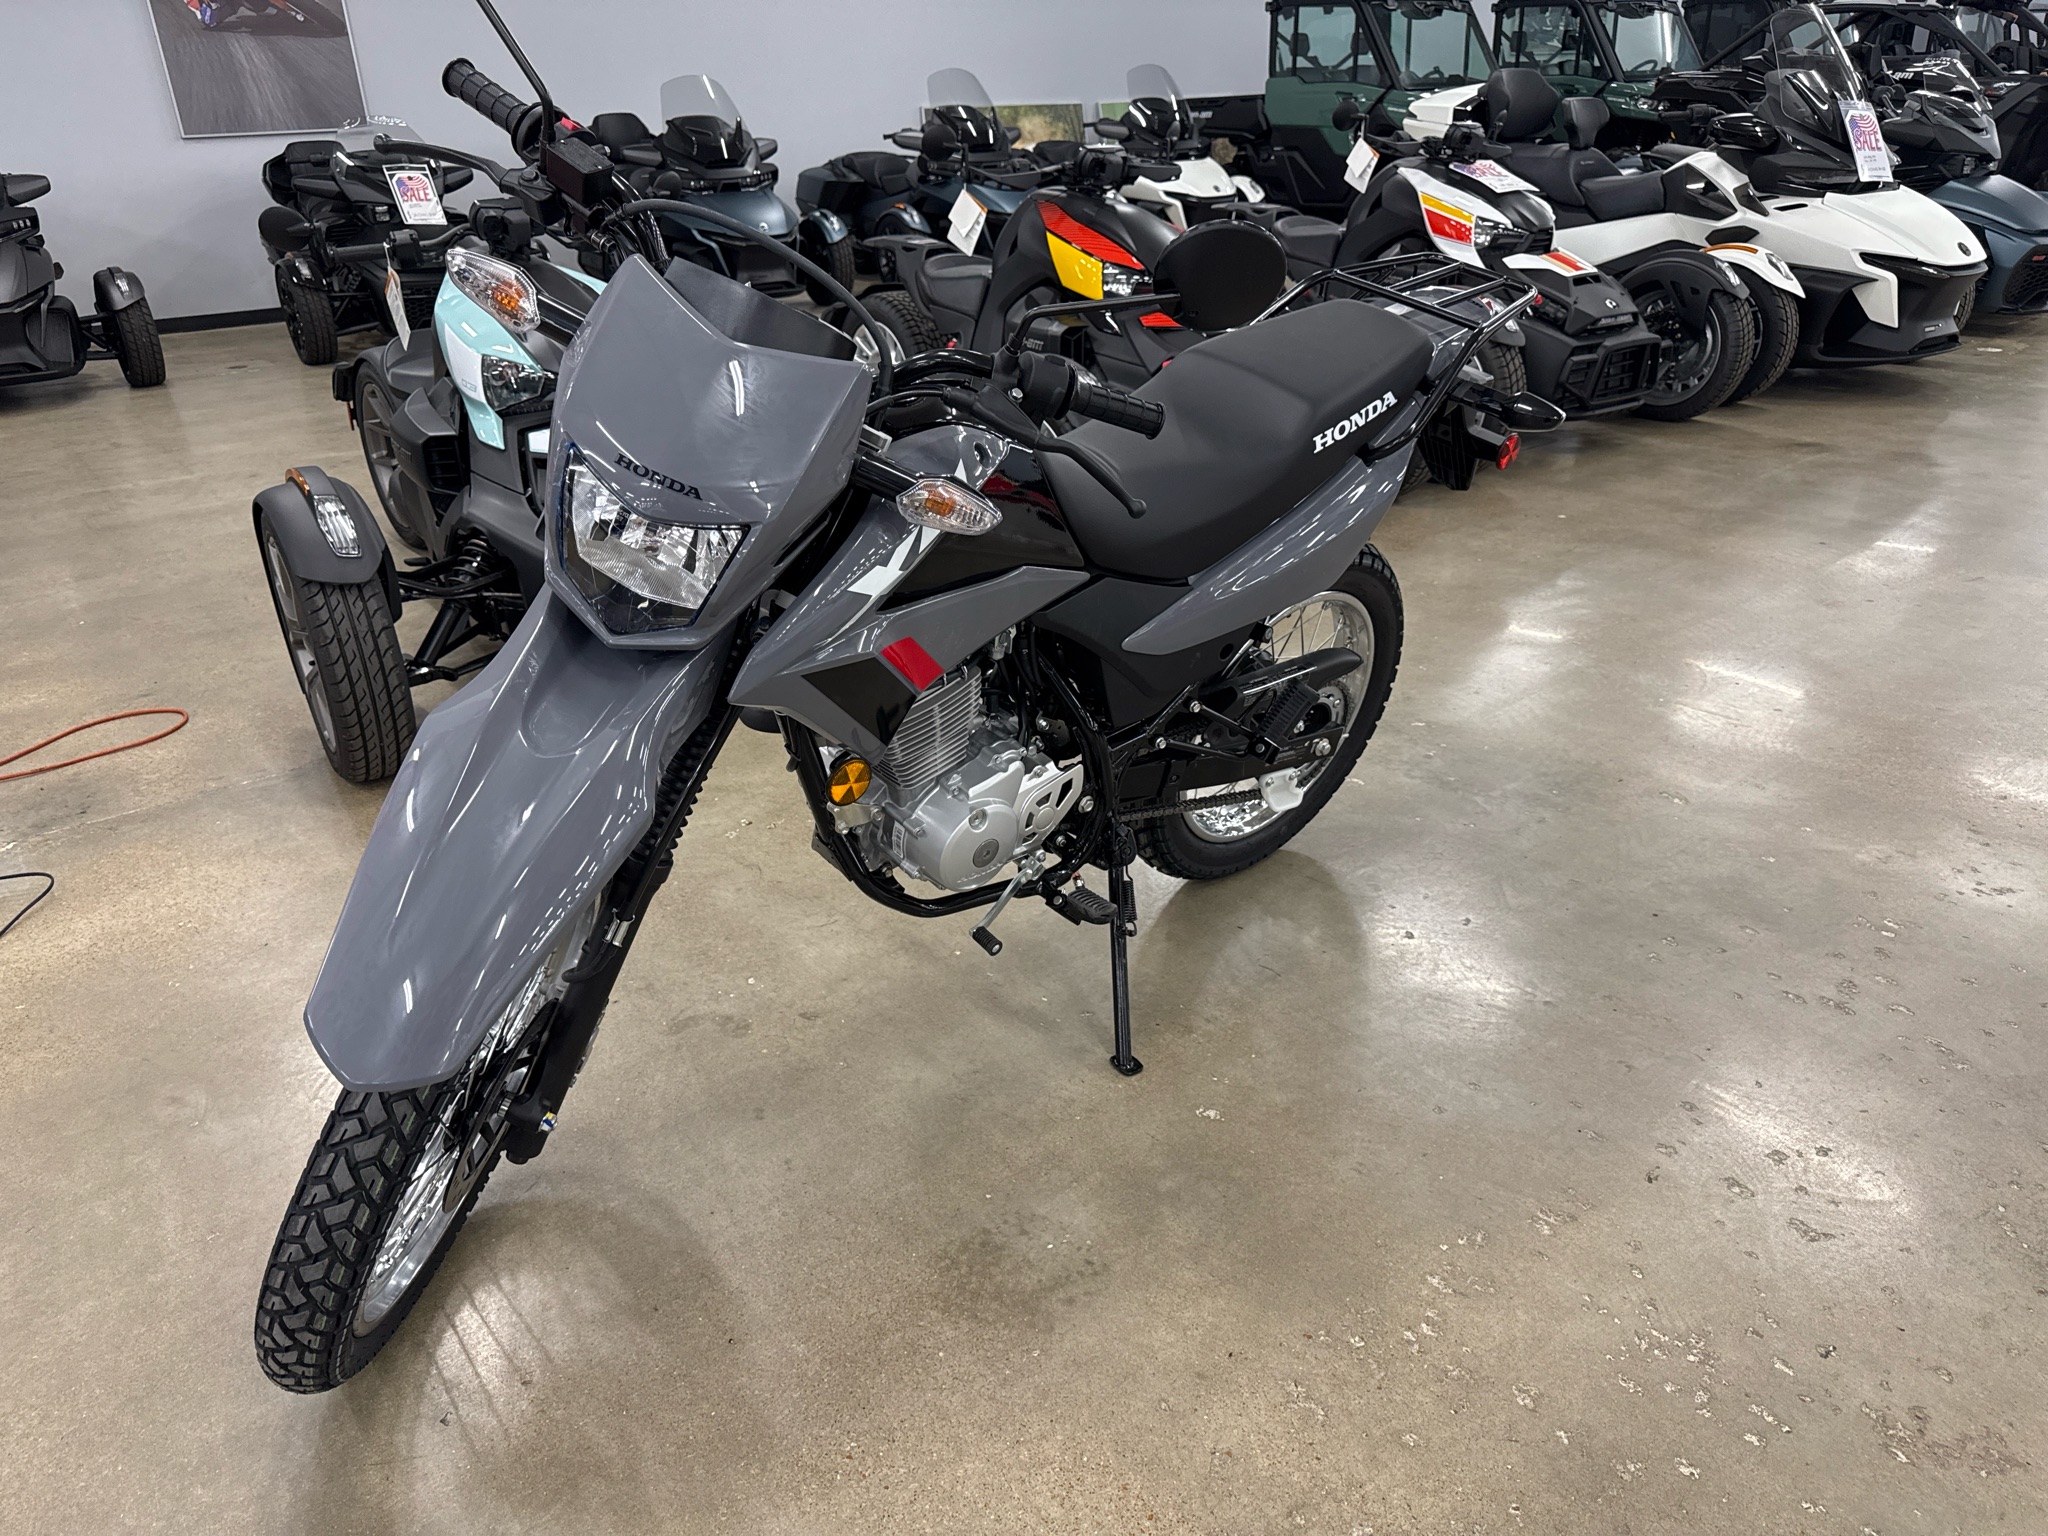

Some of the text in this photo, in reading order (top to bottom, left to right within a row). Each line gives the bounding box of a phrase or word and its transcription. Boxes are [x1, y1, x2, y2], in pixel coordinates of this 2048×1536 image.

[1854, 128, 1882, 152] SALE
[400, 186, 431, 203] SALE
[1313, 391, 1397, 453] HONDA
[614, 453, 702, 500] HONDA
